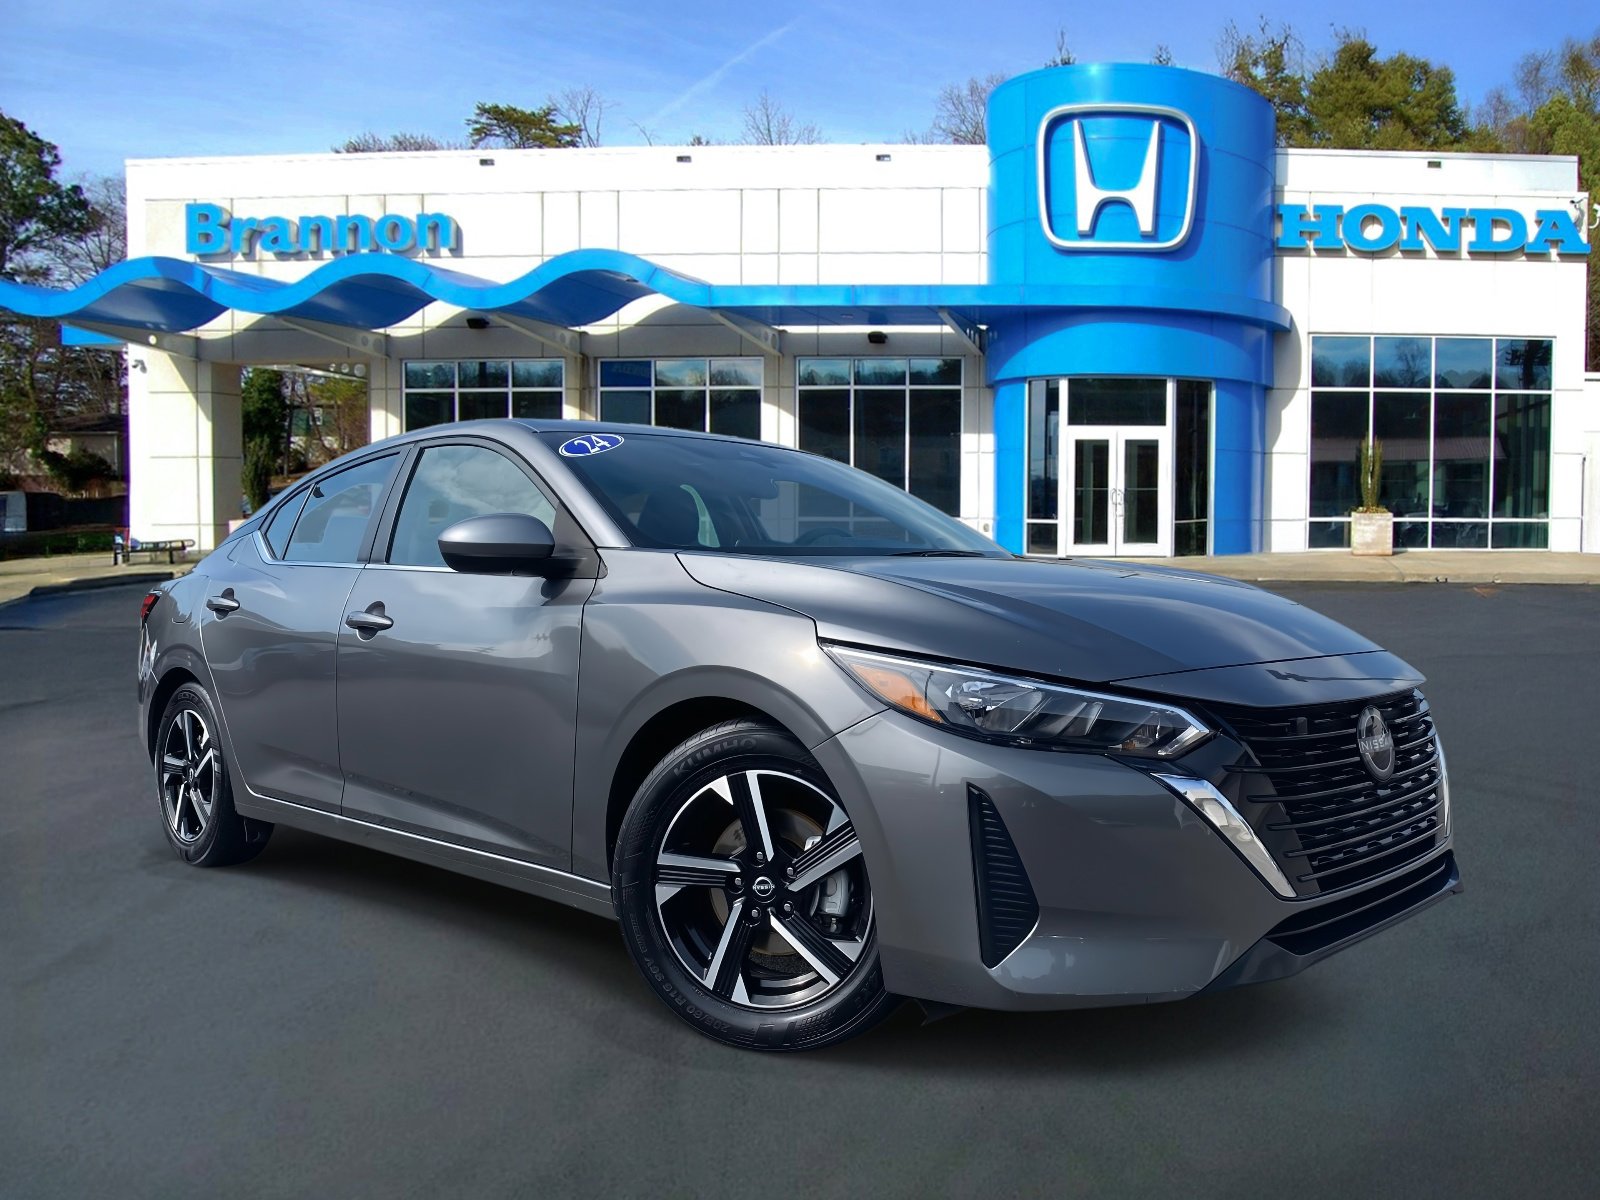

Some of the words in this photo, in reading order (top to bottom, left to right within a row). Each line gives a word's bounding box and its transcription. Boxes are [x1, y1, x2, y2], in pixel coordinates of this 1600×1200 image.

[186, 203, 460, 257] Brannon
[1277, 203, 1591, 255] HONDA
[574, 435, 611, 453] 24
[674, 737, 757, 776] KUMHO
